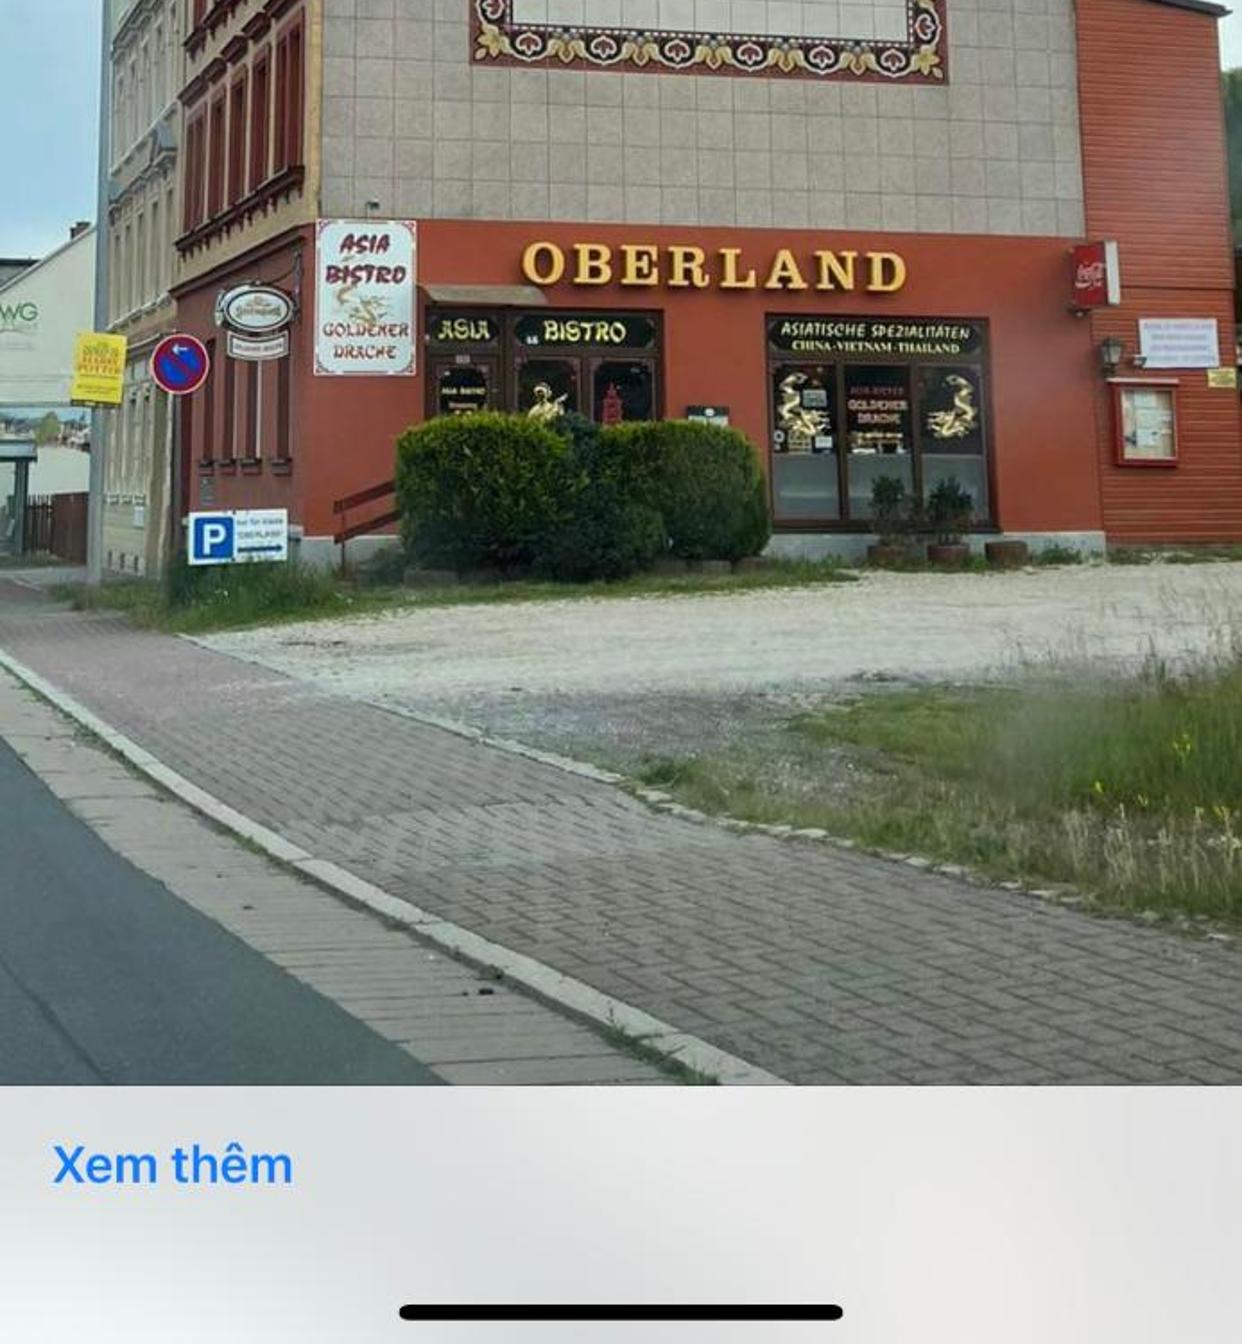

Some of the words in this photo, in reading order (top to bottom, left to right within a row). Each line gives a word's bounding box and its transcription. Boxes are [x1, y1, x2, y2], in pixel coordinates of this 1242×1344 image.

[339, 233, 390, 255] ASIA
[325, 264, 406, 285] BISTRO
[522, 241, 907, 293] OBERLAND
[322, 322, 409, 338] GOLDENER
[437, 318, 491, 340] ASIA
[543, 319, 627, 343] BISTRO
[780, 322, 866, 338] ASIATISCHE
[333, 344, 398, 360] DRACHE
[203, 523, 227, 556] P
